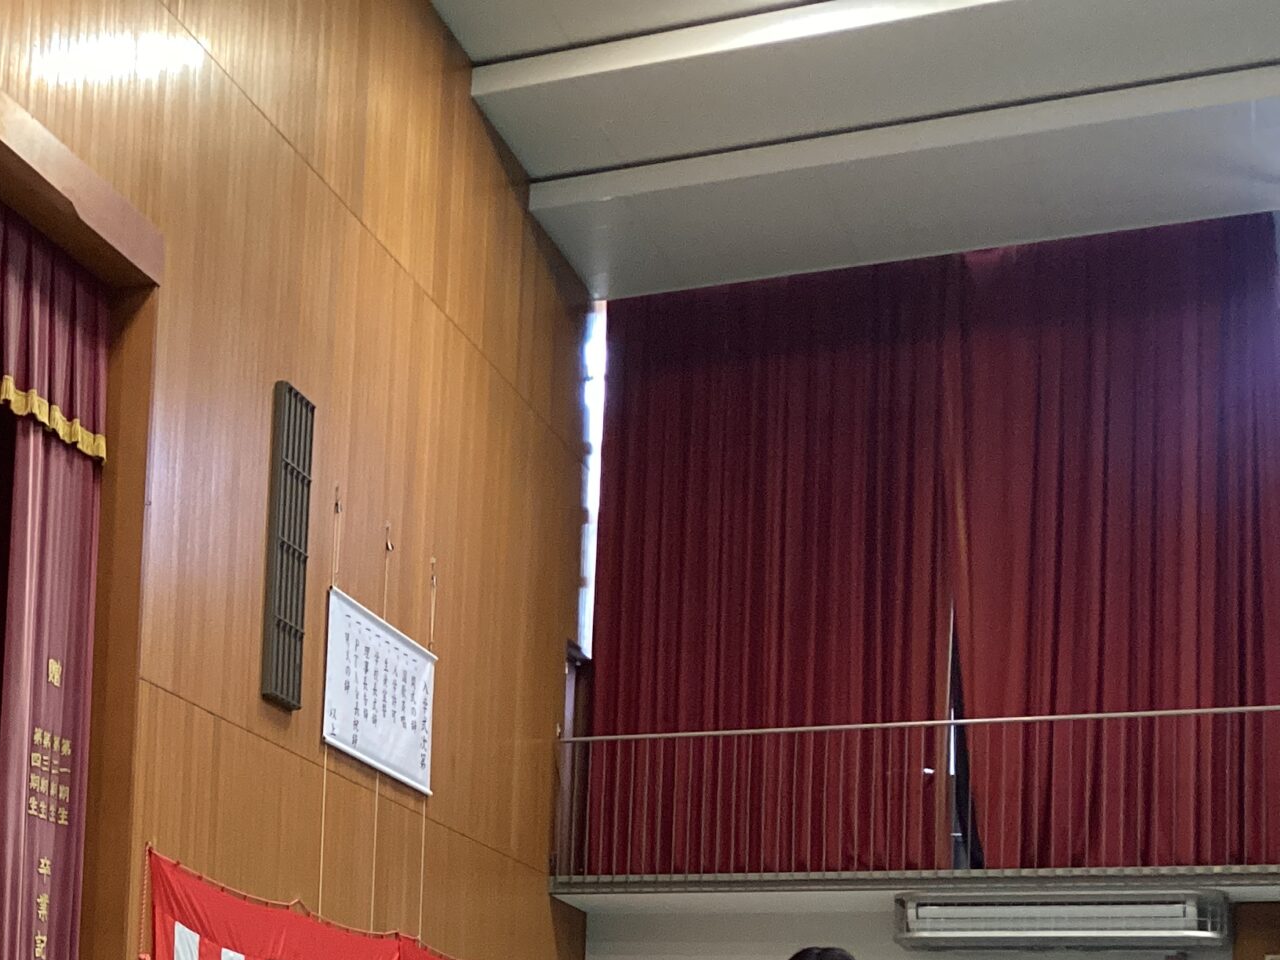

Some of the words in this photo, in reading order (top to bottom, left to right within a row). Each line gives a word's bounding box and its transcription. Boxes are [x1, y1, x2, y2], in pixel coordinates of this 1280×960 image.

[420, 681, 428, 770] 入学式次第
[27, 727, 43, 816] 第四期生
[38, 731, 52, 820] 第三期生
[57, 739, 72, 826] 第一期生
